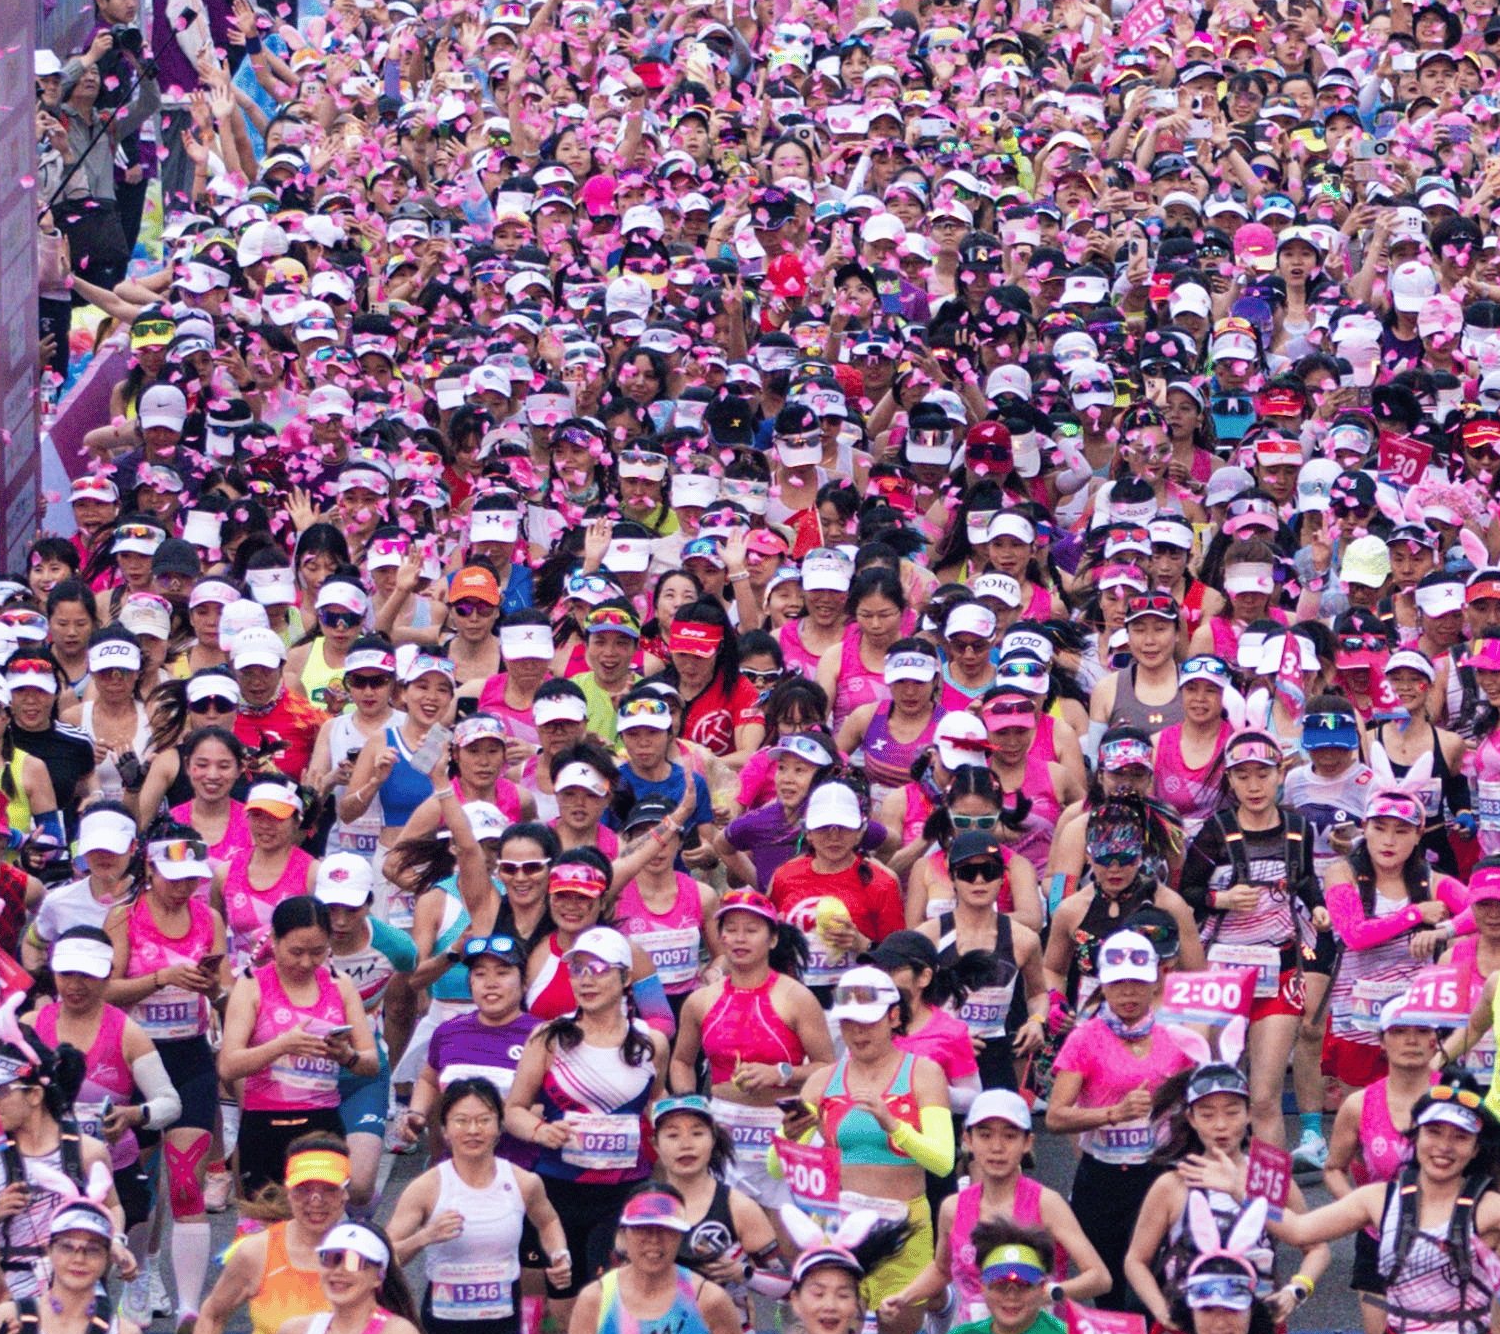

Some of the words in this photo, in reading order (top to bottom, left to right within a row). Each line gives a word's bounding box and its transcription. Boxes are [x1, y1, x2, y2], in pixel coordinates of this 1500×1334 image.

[653, 950, 689, 966] 0097
[1171, 982, 1240, 1008] 2:00
[148, 1005, 187, 1021] 1311
[961, 1006, 997, 1020] 0330
[584, 1133, 626, 1151] 0738
[733, 1127, 772, 1145] 0749
[1108, 1127, 1150, 1146] 1104
[1248, 1165, 1285, 1198] 3:15
[455, 1283, 498, 1301] 1346
